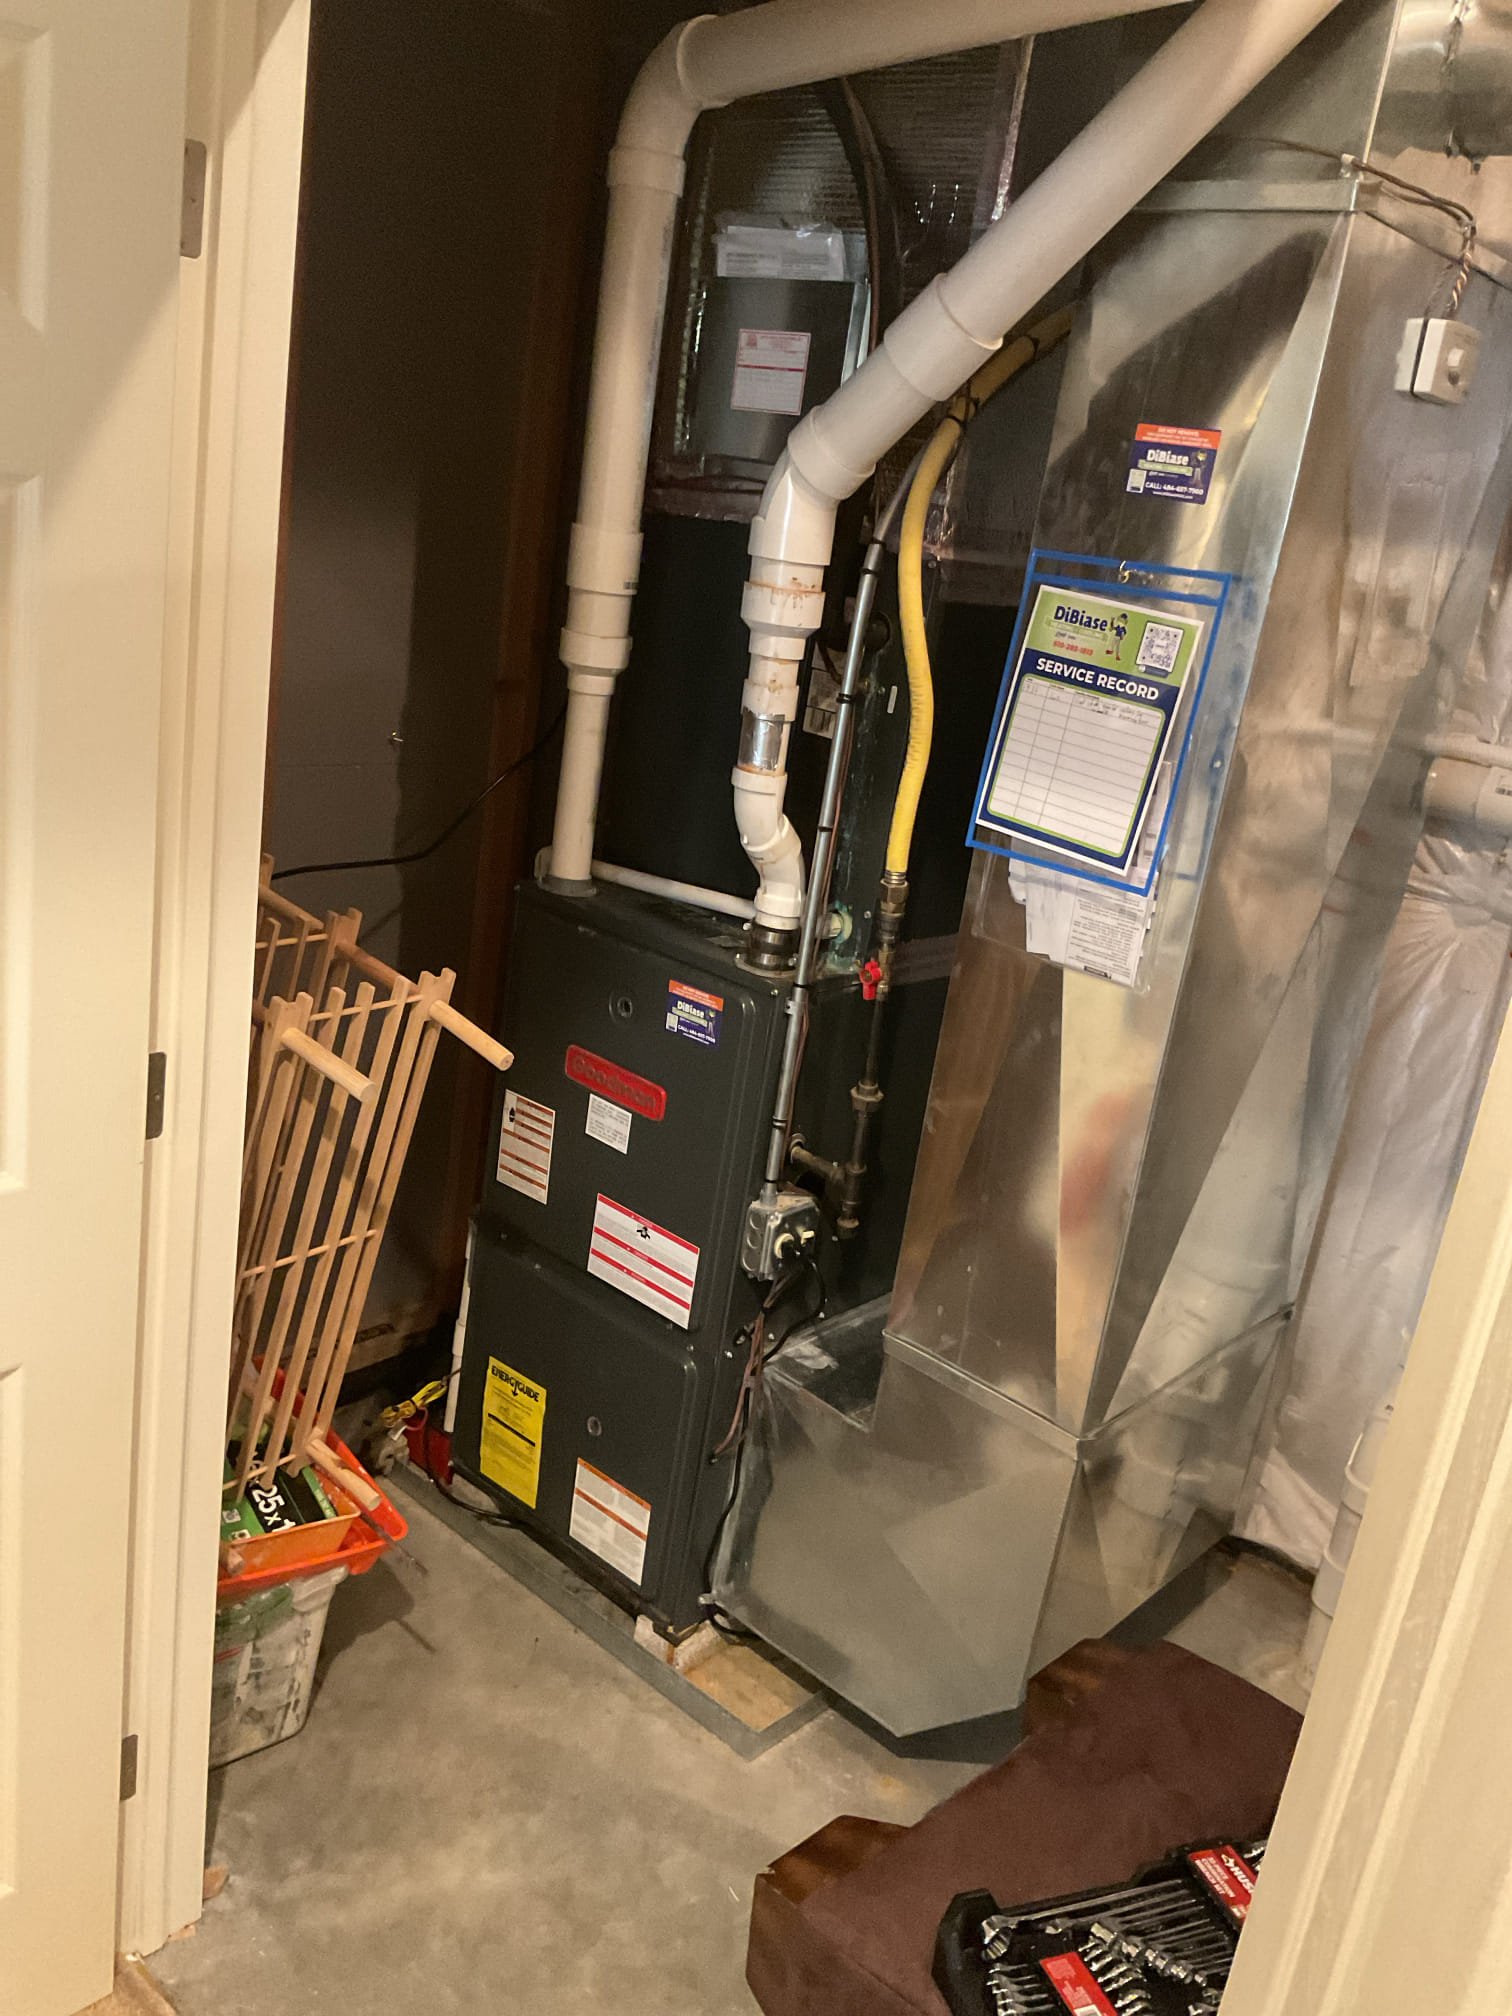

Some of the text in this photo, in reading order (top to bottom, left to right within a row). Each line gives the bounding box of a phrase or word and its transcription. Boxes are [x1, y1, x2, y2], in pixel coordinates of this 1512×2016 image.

[1146, 449, 1190, 466] DiBiase
[1053, 605, 1108, 632] DiBiase
[1036, 657, 1159, 701] SERVICE RECORD
[1230, 1867, 1256, 1894] HUS
